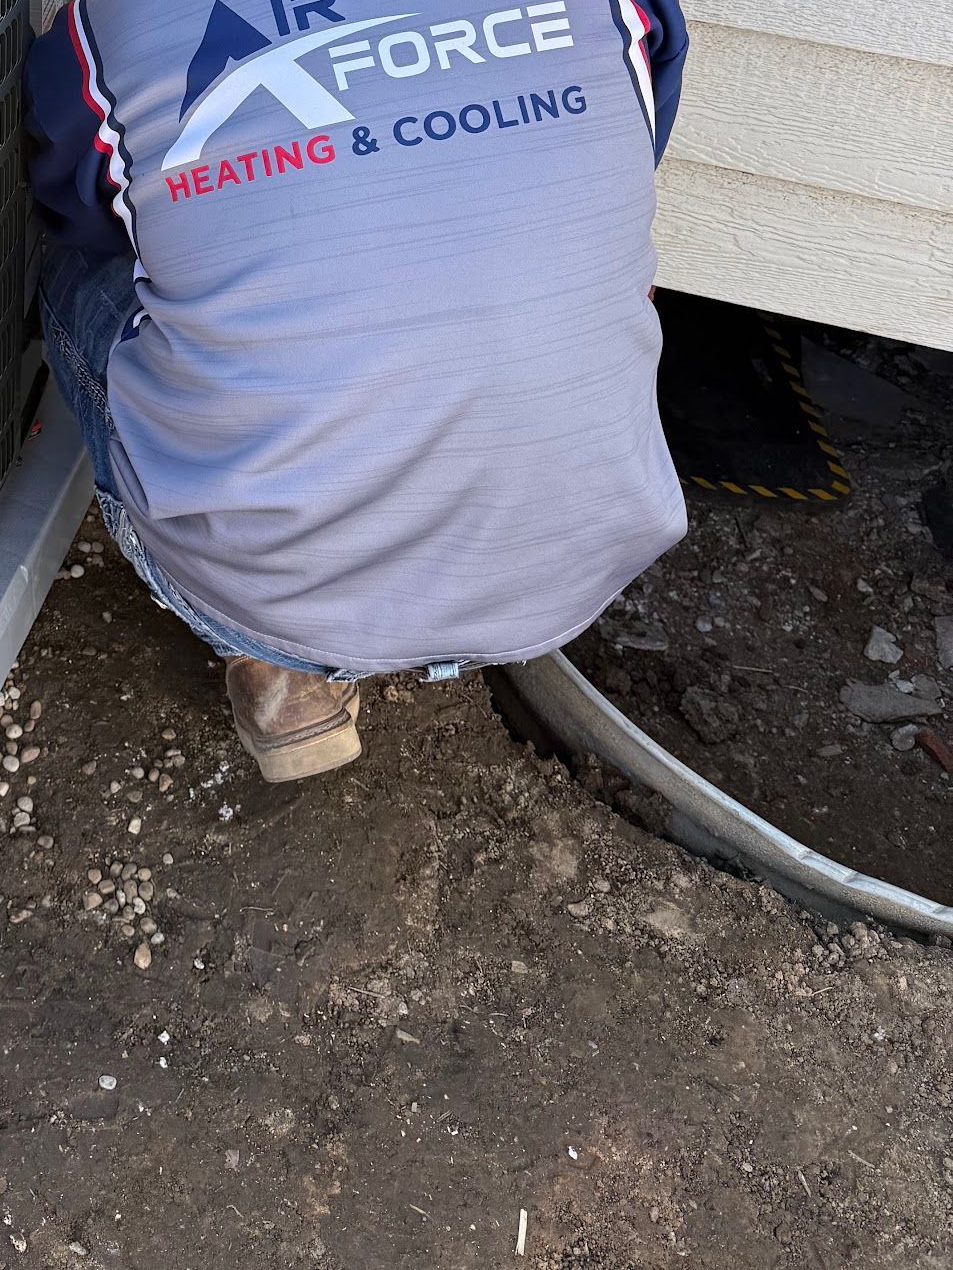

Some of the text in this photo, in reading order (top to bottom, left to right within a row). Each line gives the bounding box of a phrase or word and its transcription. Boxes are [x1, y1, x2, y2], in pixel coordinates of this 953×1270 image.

[328, 0, 574, 91] FORCE
[165, 85, 588, 202] HEATING & COOLING
